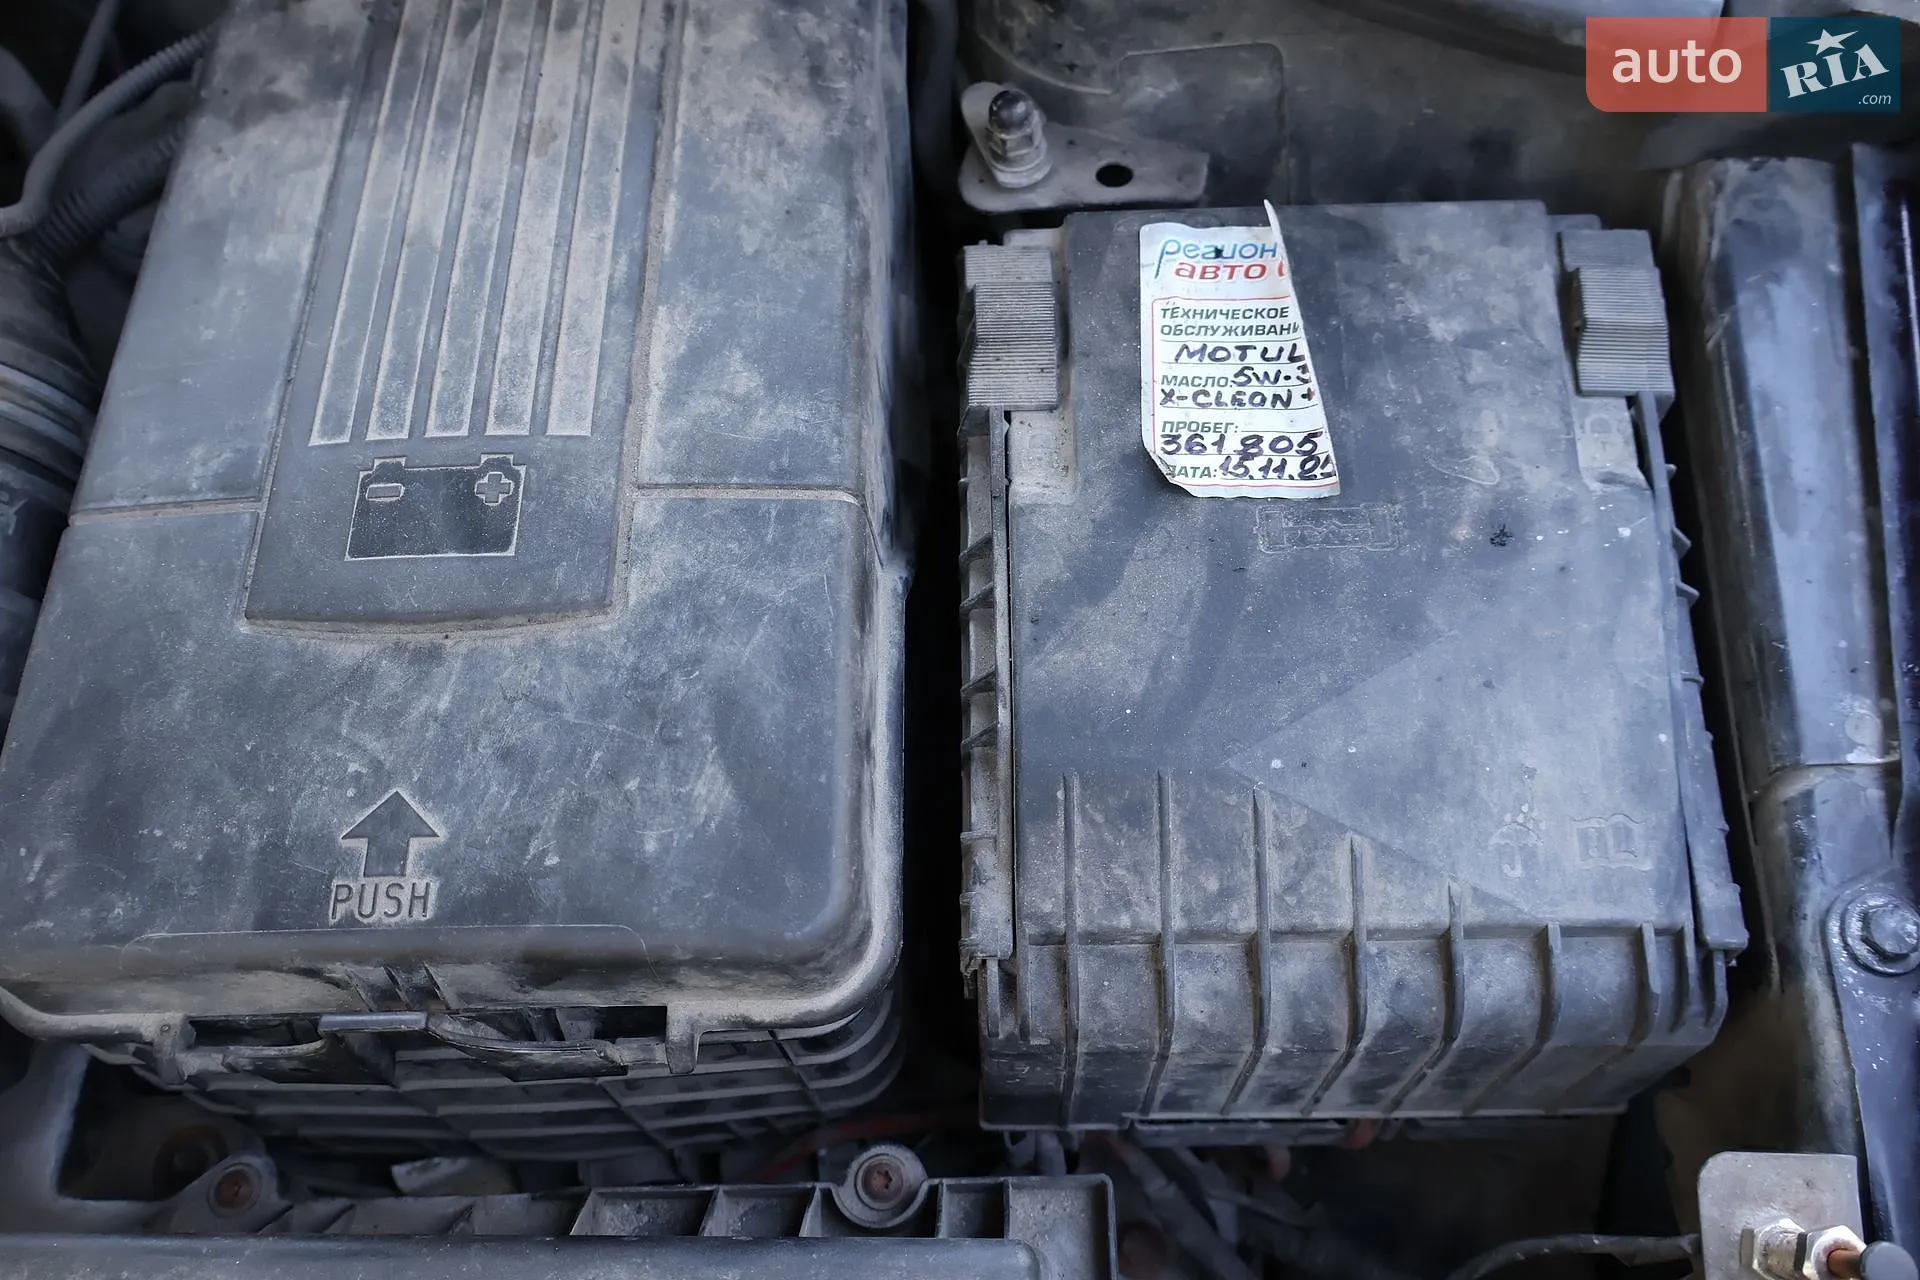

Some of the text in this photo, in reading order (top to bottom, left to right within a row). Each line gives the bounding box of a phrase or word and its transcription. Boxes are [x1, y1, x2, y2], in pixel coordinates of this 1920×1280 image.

[1160, 306, 1290, 320] ТЕХНИЧЕСКОЕ
[1174, 342, 1306, 363] MOTUL
[1161, 421, 1239, 434] ПРОБЕГ:
[330, 881, 431, 920] PUSH
